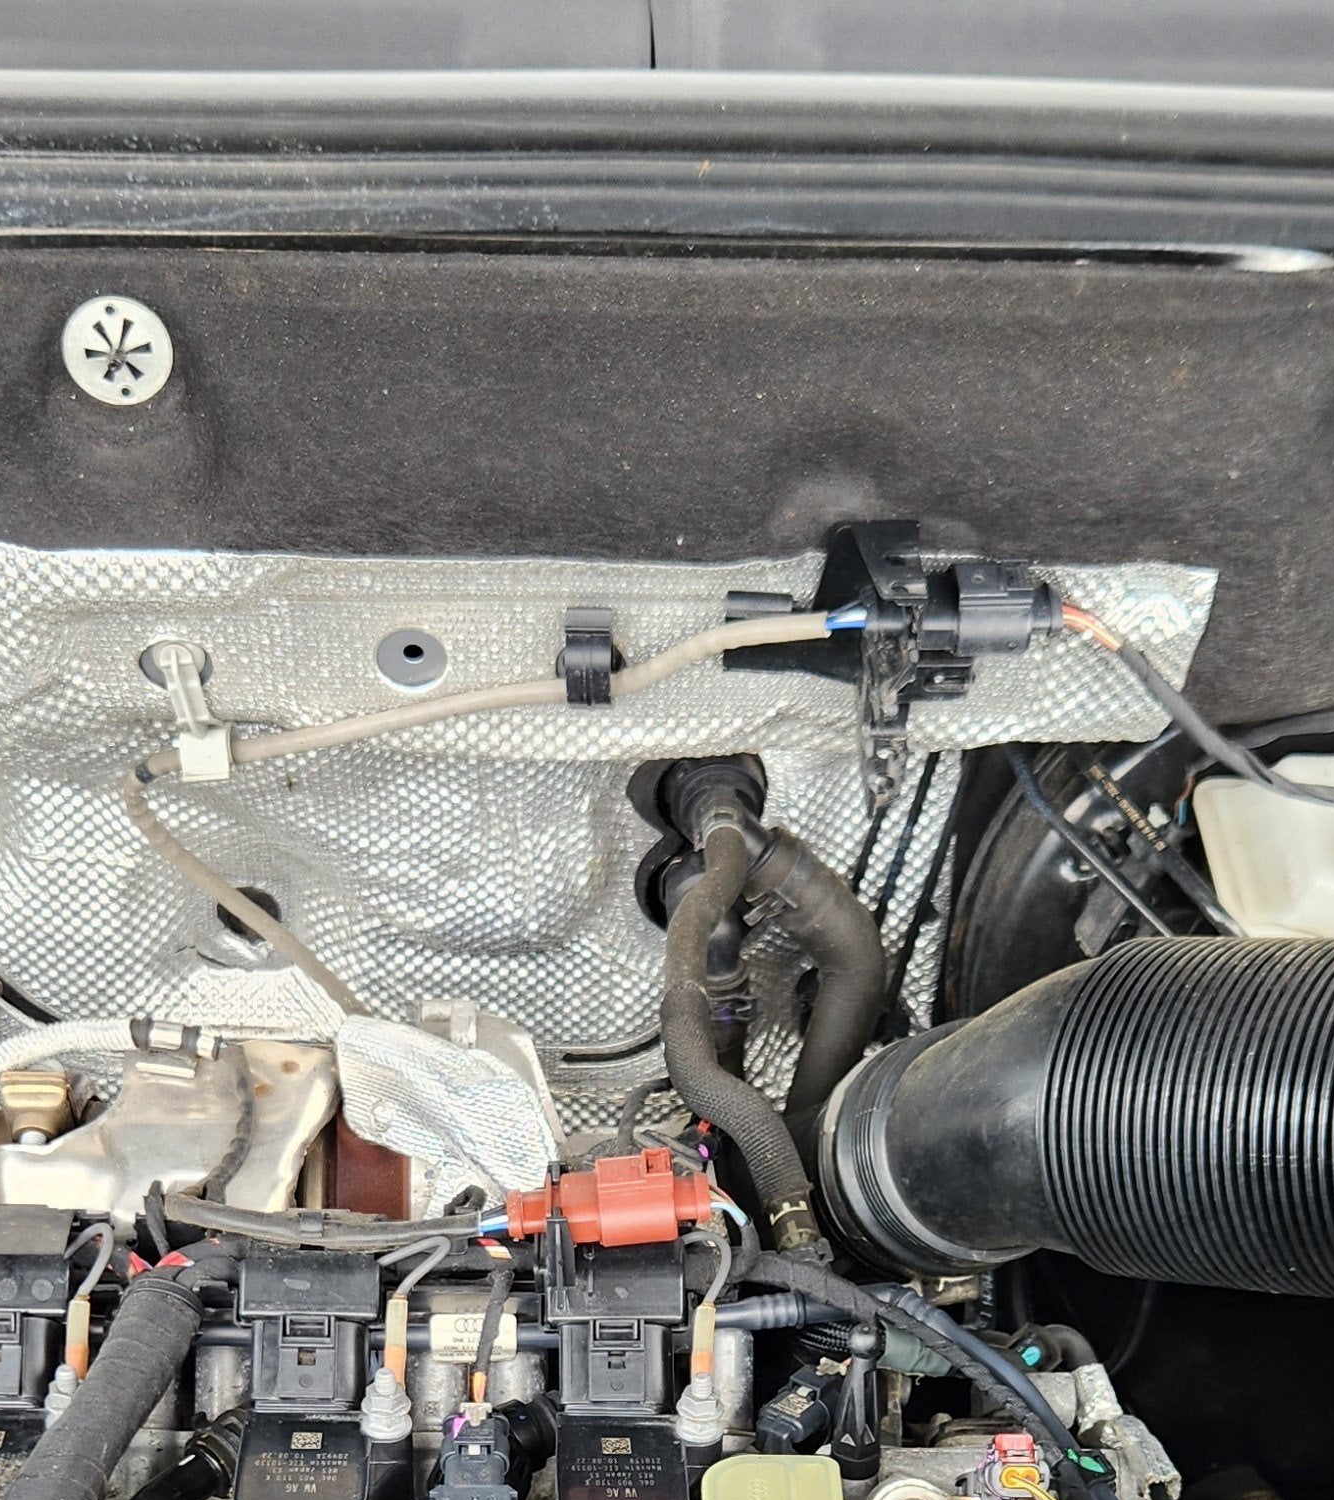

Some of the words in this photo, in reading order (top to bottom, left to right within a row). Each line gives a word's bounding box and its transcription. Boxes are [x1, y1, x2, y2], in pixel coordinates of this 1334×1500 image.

[285, 1483, 298, 1492] AG
[303, 1483, 315, 1492] VW
[605, 1487, 618, 1496] AG
[624, 1487, 636, 1496] VW
